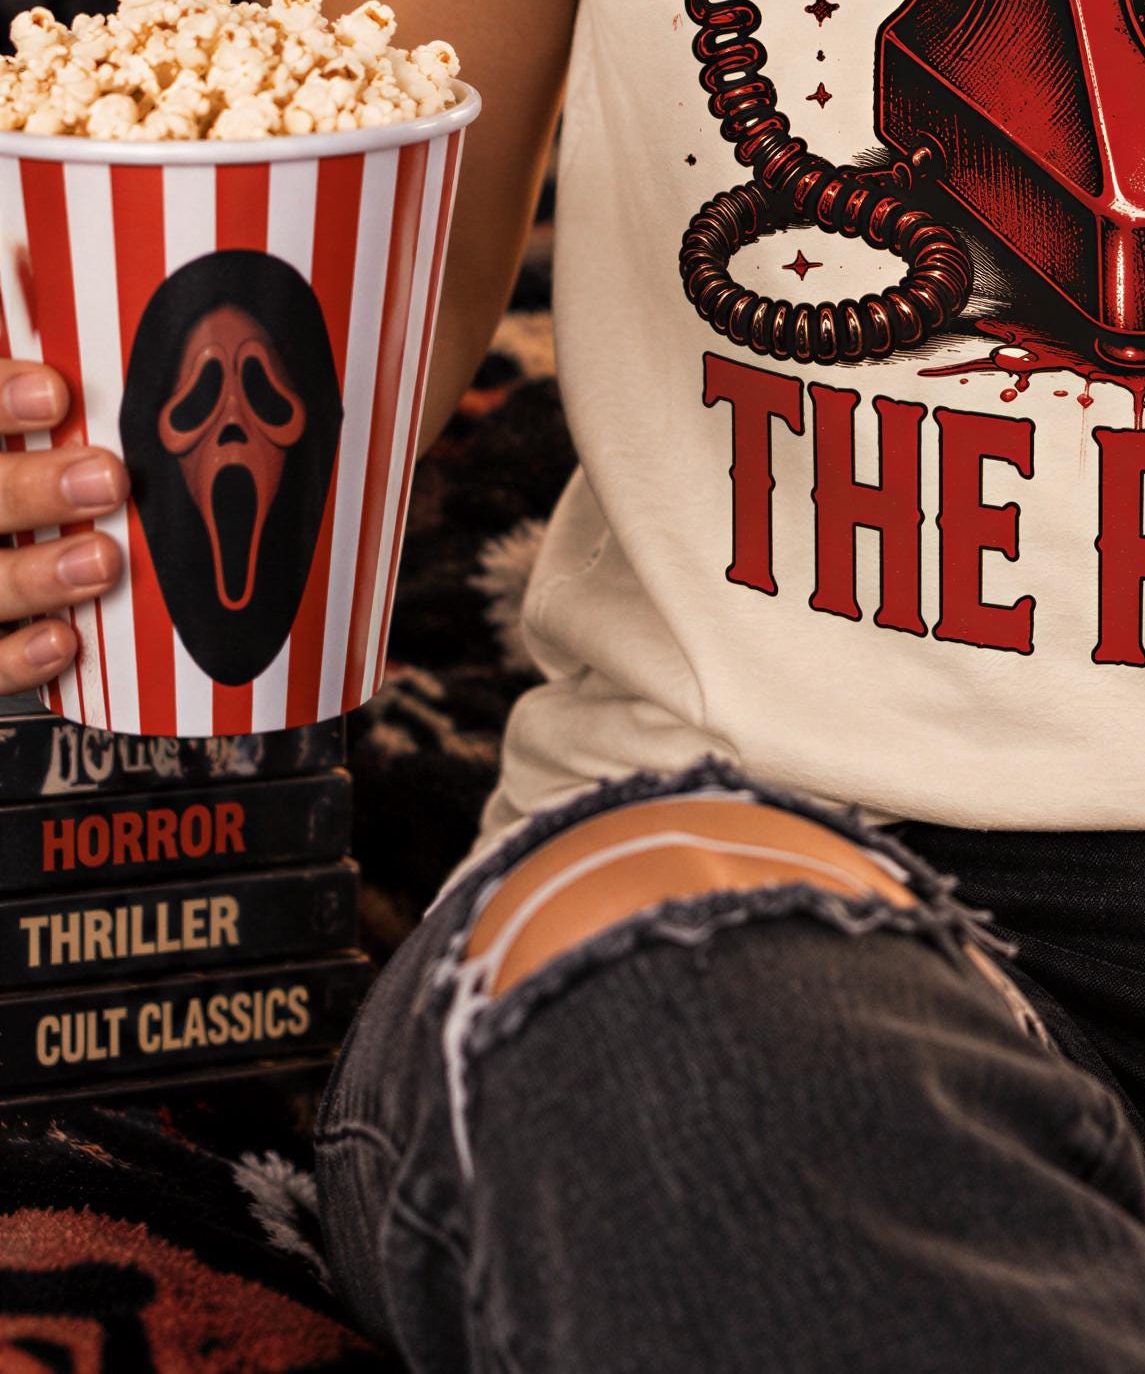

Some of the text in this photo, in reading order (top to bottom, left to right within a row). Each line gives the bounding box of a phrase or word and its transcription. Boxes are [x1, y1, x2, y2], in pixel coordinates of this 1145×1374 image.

[702, 352, 1036, 655] THE
[42, 801, 246, 872] HORROR
[20, 895, 240, 968] THRILLER
[36, 985, 310, 1066] CULT CLASSICS
